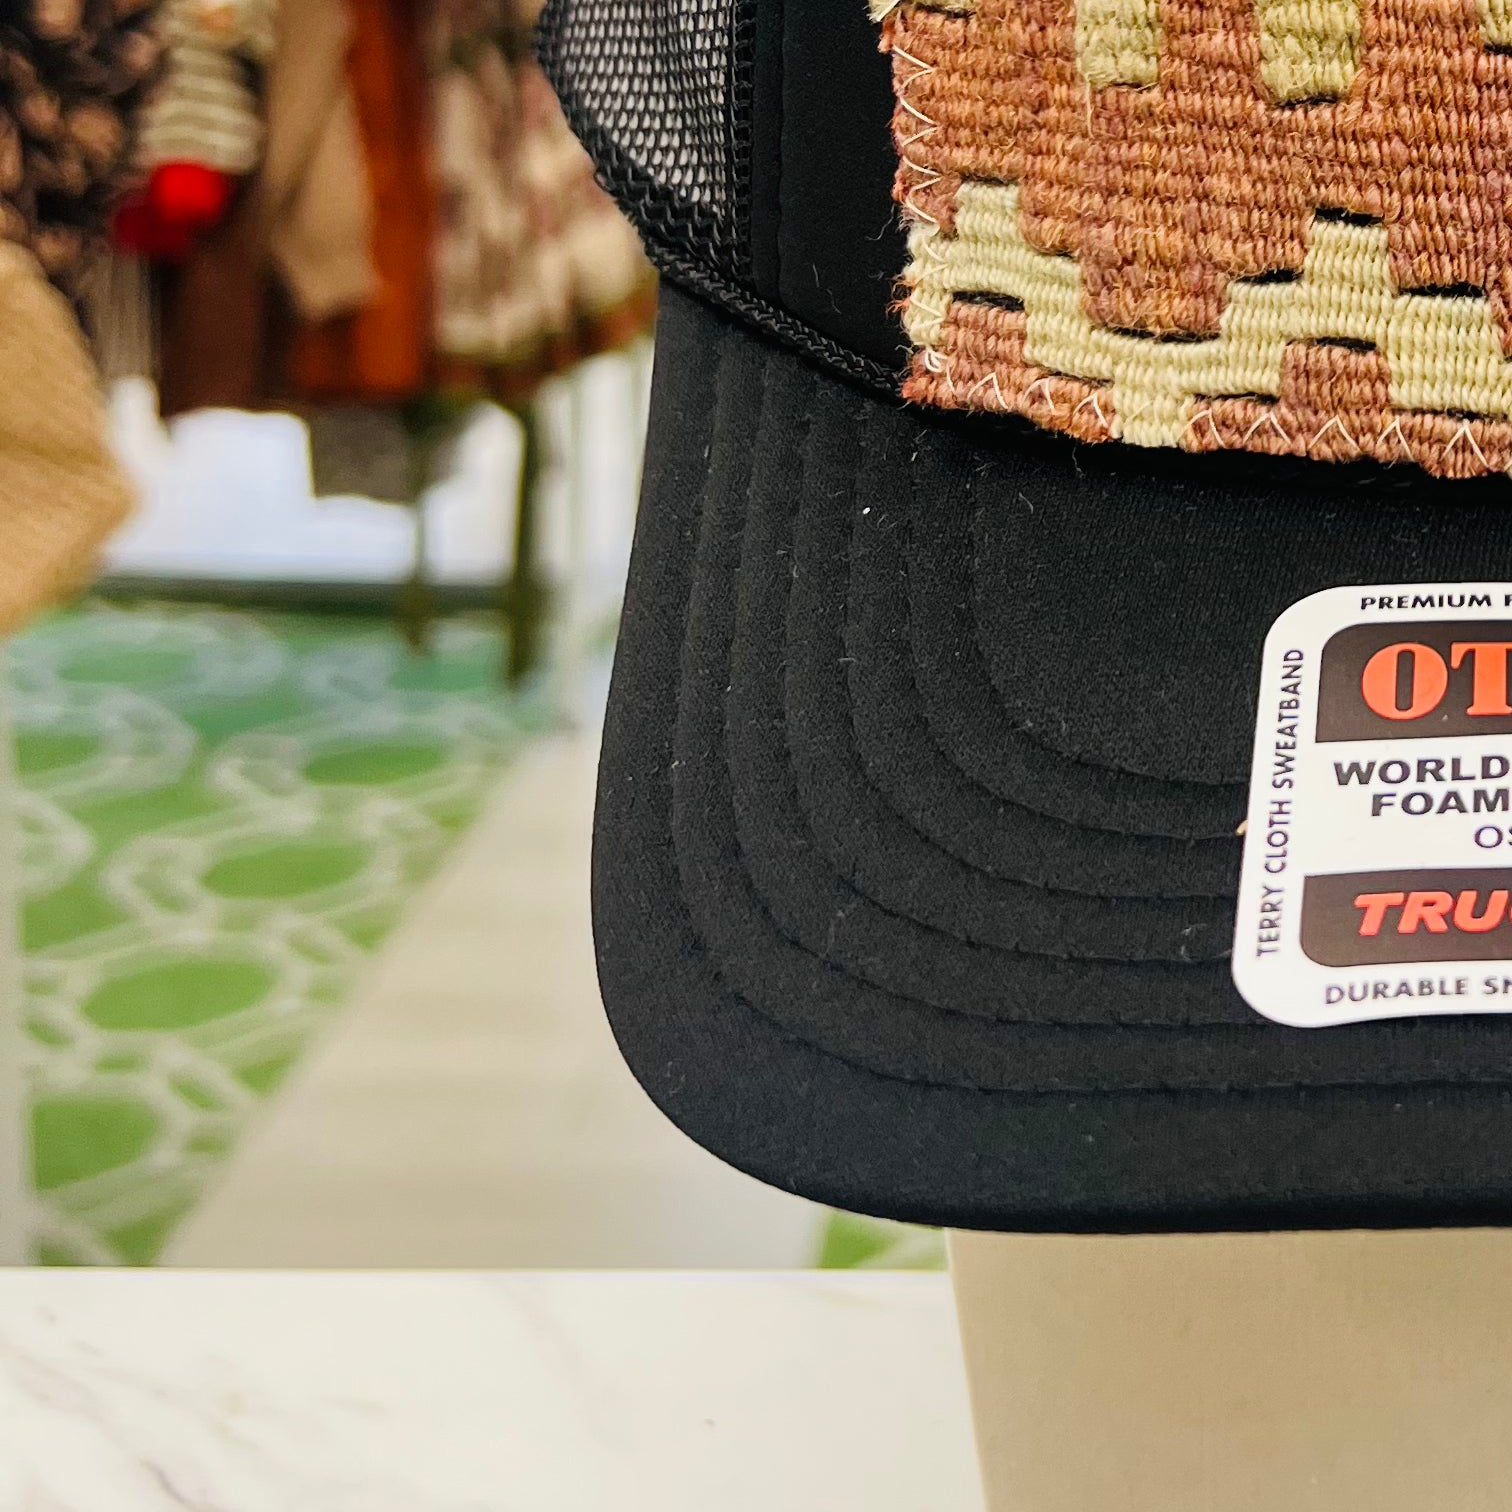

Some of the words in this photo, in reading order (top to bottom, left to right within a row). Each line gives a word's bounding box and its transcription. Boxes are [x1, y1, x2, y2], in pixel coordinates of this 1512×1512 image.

[1359, 595, 1493, 613] PREMIUM
[1271, 648, 1305, 789] SWEATBAND
[1333, 754, 1510, 787] WORLD
[1371, 788, 1509, 817] FOAM
[1263, 799, 1295, 875] CLOTH
[1255, 880, 1285, 958] TERRY
[1324, 977, 1469, 1005] DURABLE
